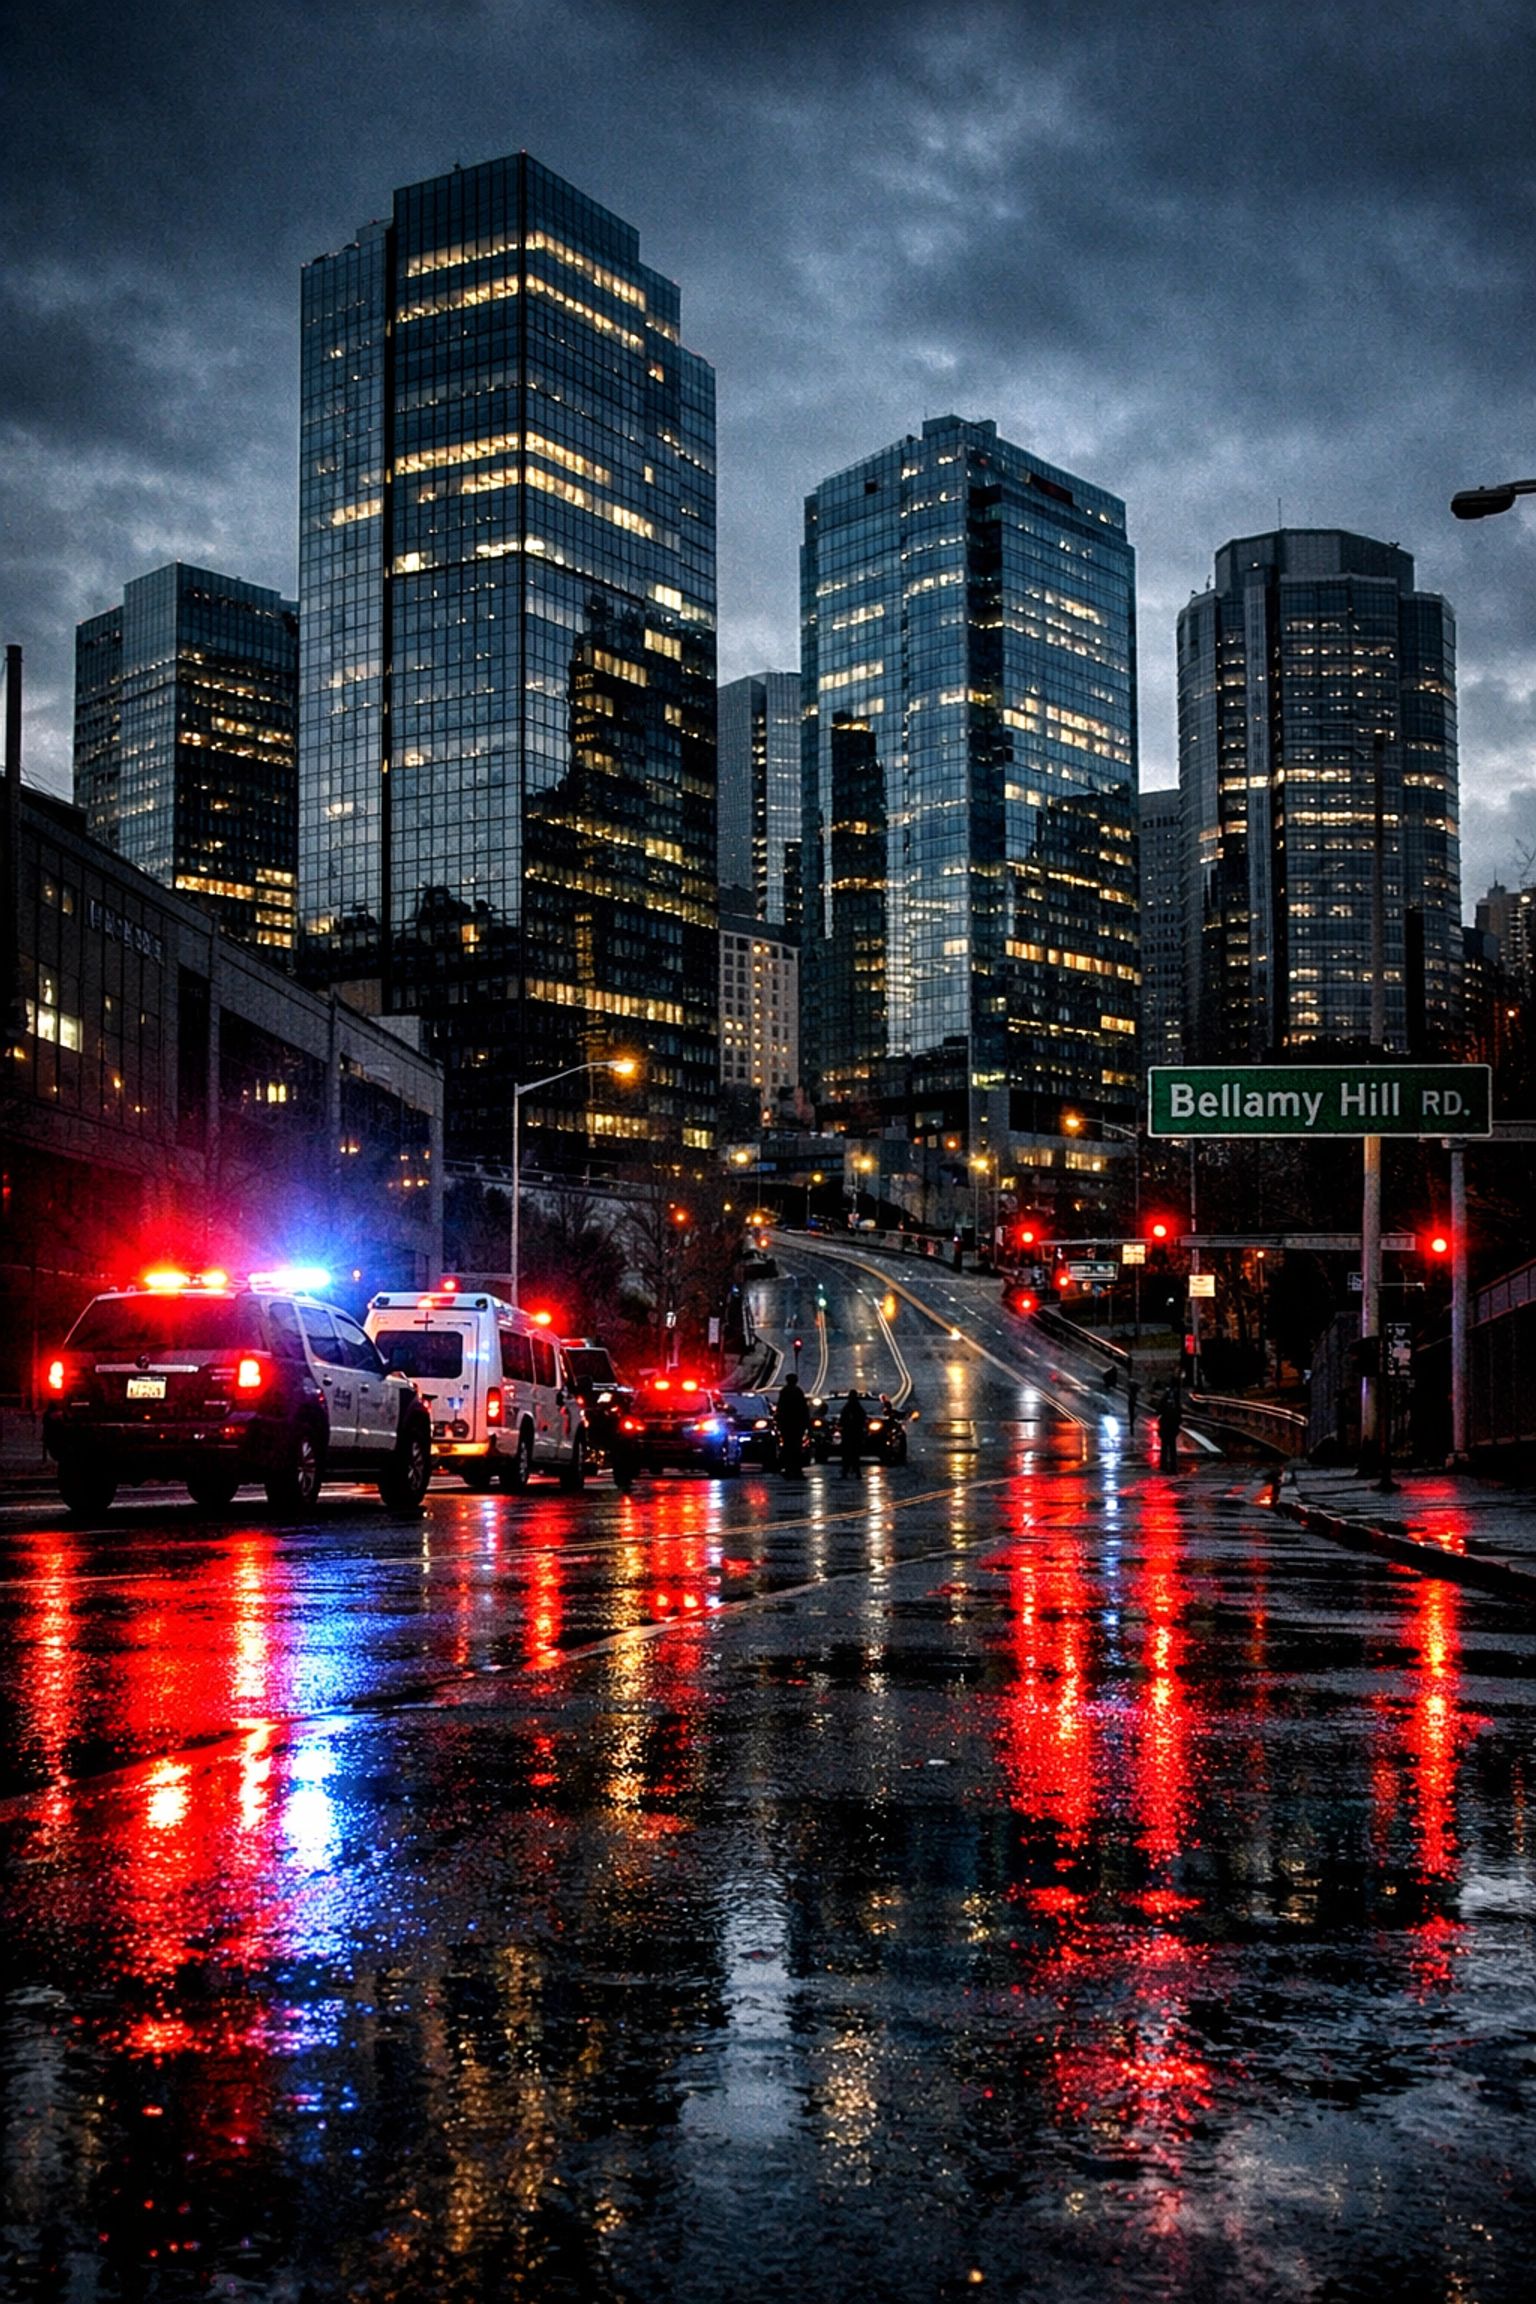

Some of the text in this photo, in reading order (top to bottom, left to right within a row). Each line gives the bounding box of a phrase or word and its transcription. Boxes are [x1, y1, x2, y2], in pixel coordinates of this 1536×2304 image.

[1170, 1082, 1471, 1126] Bellamy Hill RD.
